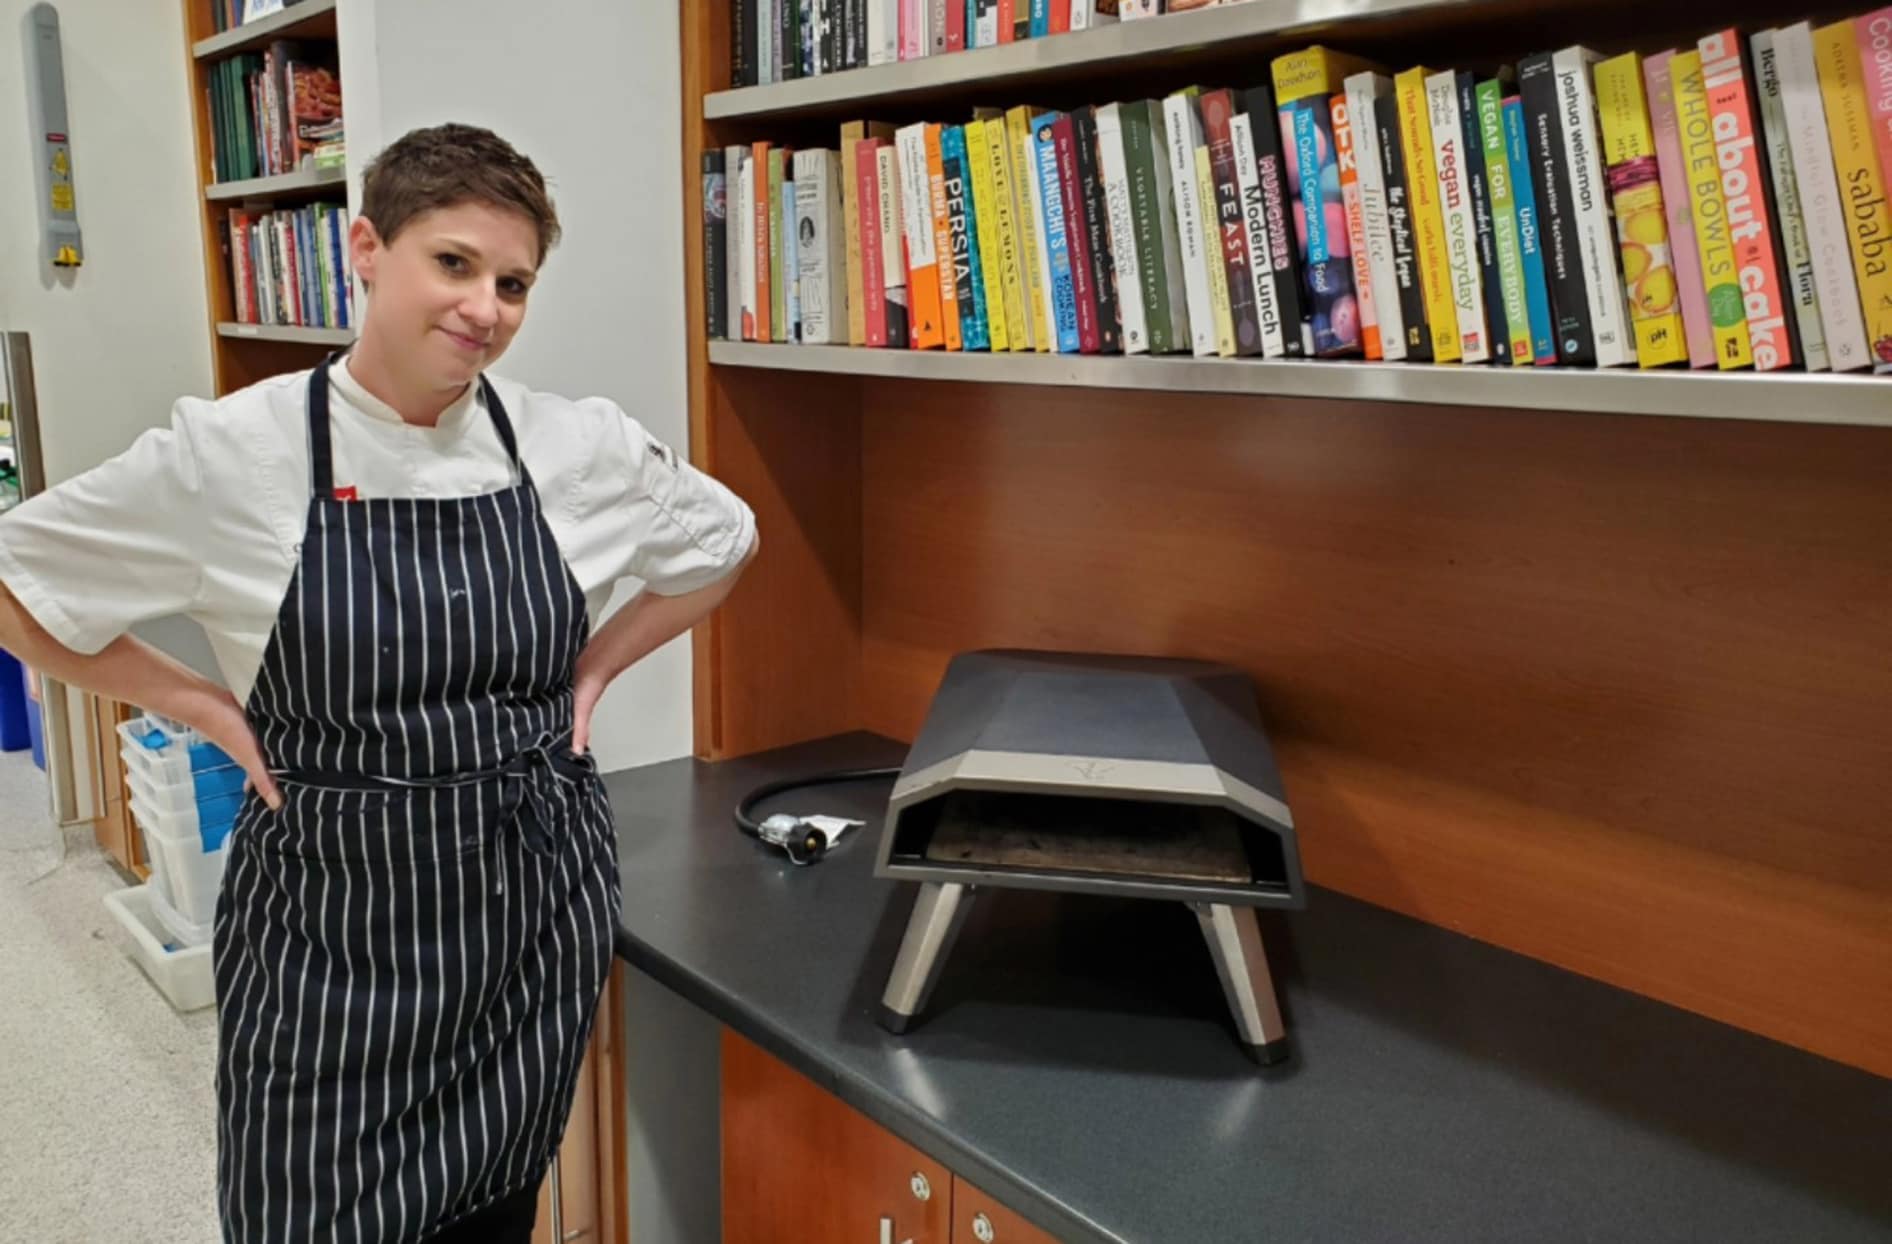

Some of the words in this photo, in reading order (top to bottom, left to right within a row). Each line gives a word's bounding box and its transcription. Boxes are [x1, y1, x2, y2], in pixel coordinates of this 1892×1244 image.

[1698, 30, 1741, 89] all
[1758, 47, 1781, 99] Bergo
[1296, 112, 1312, 135] The
[1332, 104, 1356, 172] OTK
[1478, 88, 1501, 150] VEGAN
[1534, 112, 1553, 158] Sensory
[1558, 70, 1580, 125] joshua
[1569, 128, 1592, 211] weissman
[878, 154, 889, 189] DAVID
[913, 174, 921, 196] Guide
[1107, 182, 1117, 192] A
[1298, 135, 1317, 175] Oxford
[1439, 137, 1461, 209] vegan
[1488, 162, 1508, 201] FOR
[1542, 158, 1560, 216] Evaluation
[1679, 70, 1712, 172] WHOLE
[1696, 180, 1731, 276] BOWLS
[1714, 109, 1762, 240] about
[931, 173, 946, 217] BURMA
[992, 143, 1005, 187] LOVE
[1000, 209, 1016, 285] LEMONS
[1039, 143, 1066, 250] MAANGCHI'S
[1181, 180, 1192, 217] ALISON
[1219, 182, 1244, 267] FEAST
[1260, 154, 1289, 270] MUNCHIES
[1302, 177, 1325, 245] Companion
[1346, 201, 1365, 244] SHELF
[1363, 182, 1391, 262] Jubilee
[1846, 166, 1892, 278] sababa
[945, 176, 971, 281] PERSIA
[1084, 174, 1094, 196] The
[1093, 253, 1107, 305] Cookbook
[1108, 194, 1129, 279] COOKBOOK
[1134, 166, 1151, 242] VEGETABLE
[1143, 247, 1159, 310] LITERACY
[1185, 220, 1196, 258] ROMAN
[1243, 184, 1266, 267] Modern
[1256, 270, 1278, 336] Lunch
[1313, 245, 1326, 260] to
[1448, 210, 1476, 312] everyday
[1517, 205, 1537, 254] UnDiet
[1548, 218, 1568, 279] Techniques
[936, 229, 955, 301] SUPERSTAR
[1313, 261, 1330, 293] Food
[1353, 248, 1371, 289] LOVE
[1497, 214, 1524, 324] EVERYBODY
[1795, 259, 1817, 307] Flora
[1738, 262, 1784, 372] cake
